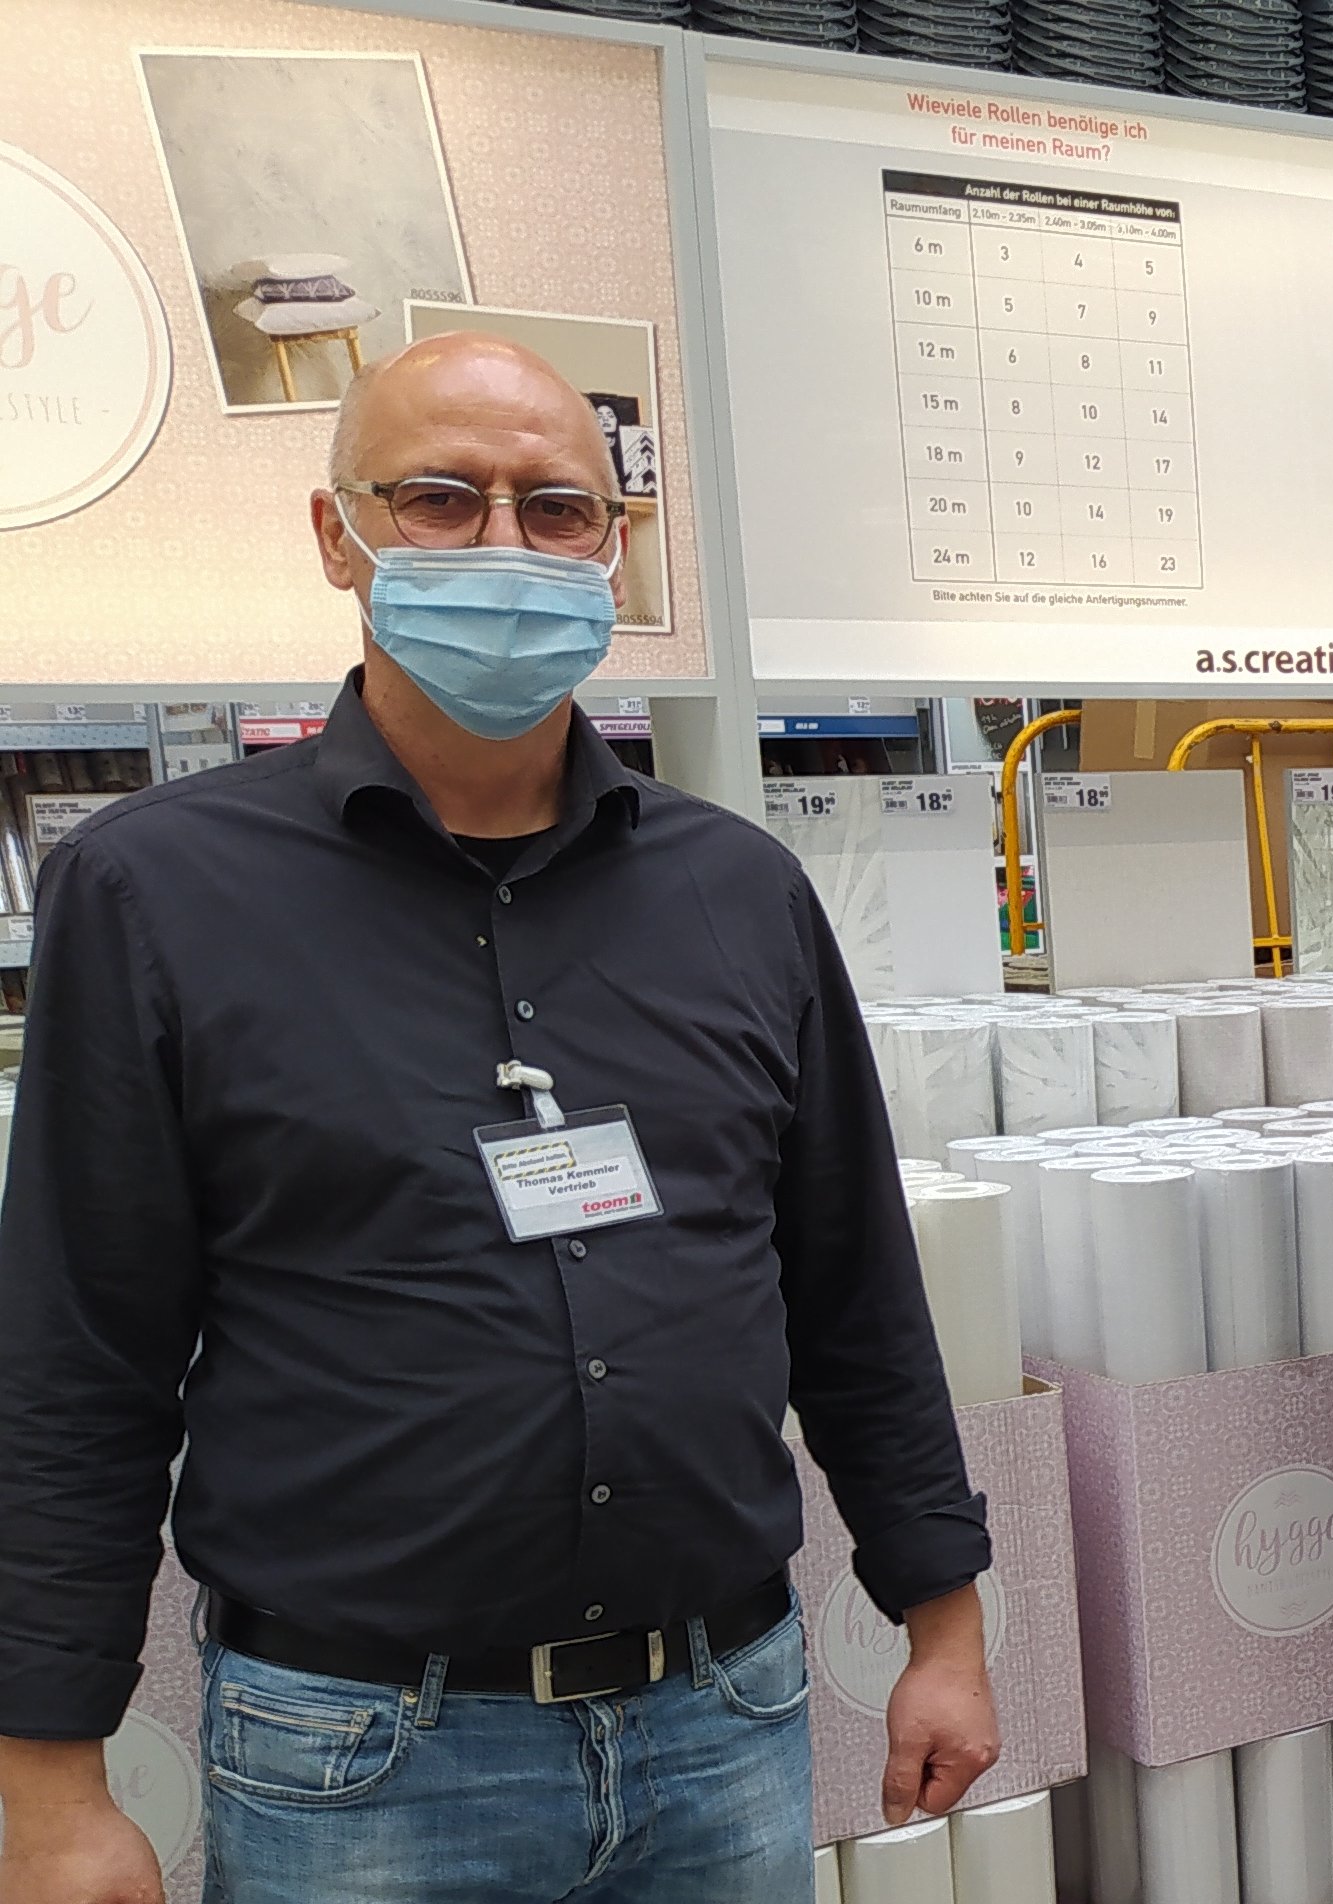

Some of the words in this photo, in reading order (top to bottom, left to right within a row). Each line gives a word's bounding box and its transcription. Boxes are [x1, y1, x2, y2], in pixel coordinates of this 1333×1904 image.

[907, 93, 982, 119] Wieviele
[987, 102, 1042, 127] Rollen
[1047, 110, 1119, 139] benötige
[1123, 120, 1148, 139] ich
[951, 126, 977, 146] für
[982, 131, 1047, 154] meinen
[1052, 138, 1111, 161] Raum?
[964, 184, 1001, 201] Anzahl
[1003, 189, 1020, 202] der
[1022, 190, 1054, 205] Rollen
[1056, 193, 1072, 207] bei
[1074, 196, 1099, 210] einer
[1101, 199, 1154, 217] Raumhöhe
[890, 199, 962, 219] Raumumfang
[914, 238, 925, 254] 6
[926, 241, 943, 256] m
[1000, 246, 1010, 261] 3
[1074, 253, 1084, 268] 4
[1144, 260, 1154, 276] 5
[914, 290, 933, 306] 10
[935, 293, 951, 308] m
[1003, 298, 1014, 313] 5
[1077, 304, 1087, 319] 7
[1148, 310, 1157, 325] 9
[918, 342, 935, 358] 12
[939, 346, 955, 360] m
[1008, 349, 1017, 364] 6
[1080, 355, 1091, 369] 8
[1149, 359, 1163, 375] 11
[921, 393, 940, 410] 15
[943, 397, 959, 411] m
[1011, 399, 1021, 415] 8
[1081, 404, 1098, 420] 10
[1152, 409, 1168, 425] 14
[926, 445, 944, 462] 18
[947, 449, 963, 463] m
[1015, 451, 1024, 466] 9
[1084, 454, 1101, 470] 12
[1154, 458, 1171, 474] 17
[929, 498, 947, 514] 20
[951, 500, 967, 515] m
[1015, 501, 1032, 517] 10
[1088, 504, 1104, 520] 14
[1158, 507, 1174, 523] 19
[933, 549, 951, 565] 24
[955, 552, 971, 566] m
[1019, 551, 1036, 567] 12
[1091, 554, 1107, 569] 16
[1159, 556, 1176, 571] 23
[933, 590, 956, 602] Bitte
[958, 592, 992, 602] achten
[994, 592, 1011, 603] Sie
[1013, 592, 1029, 604] auf
[1031, 593, 1047, 604] die
[1048, 593, 1083, 606] gleiche
[1085, 596, 1188, 608] Anfertigungsnummer.
[516, 1174, 564, 1189] Thomas
[566, 1163, 620, 1179] Kemmler
[548, 1180, 597, 1196] Vertrieb
[581, 1196, 629, 1212] toom
